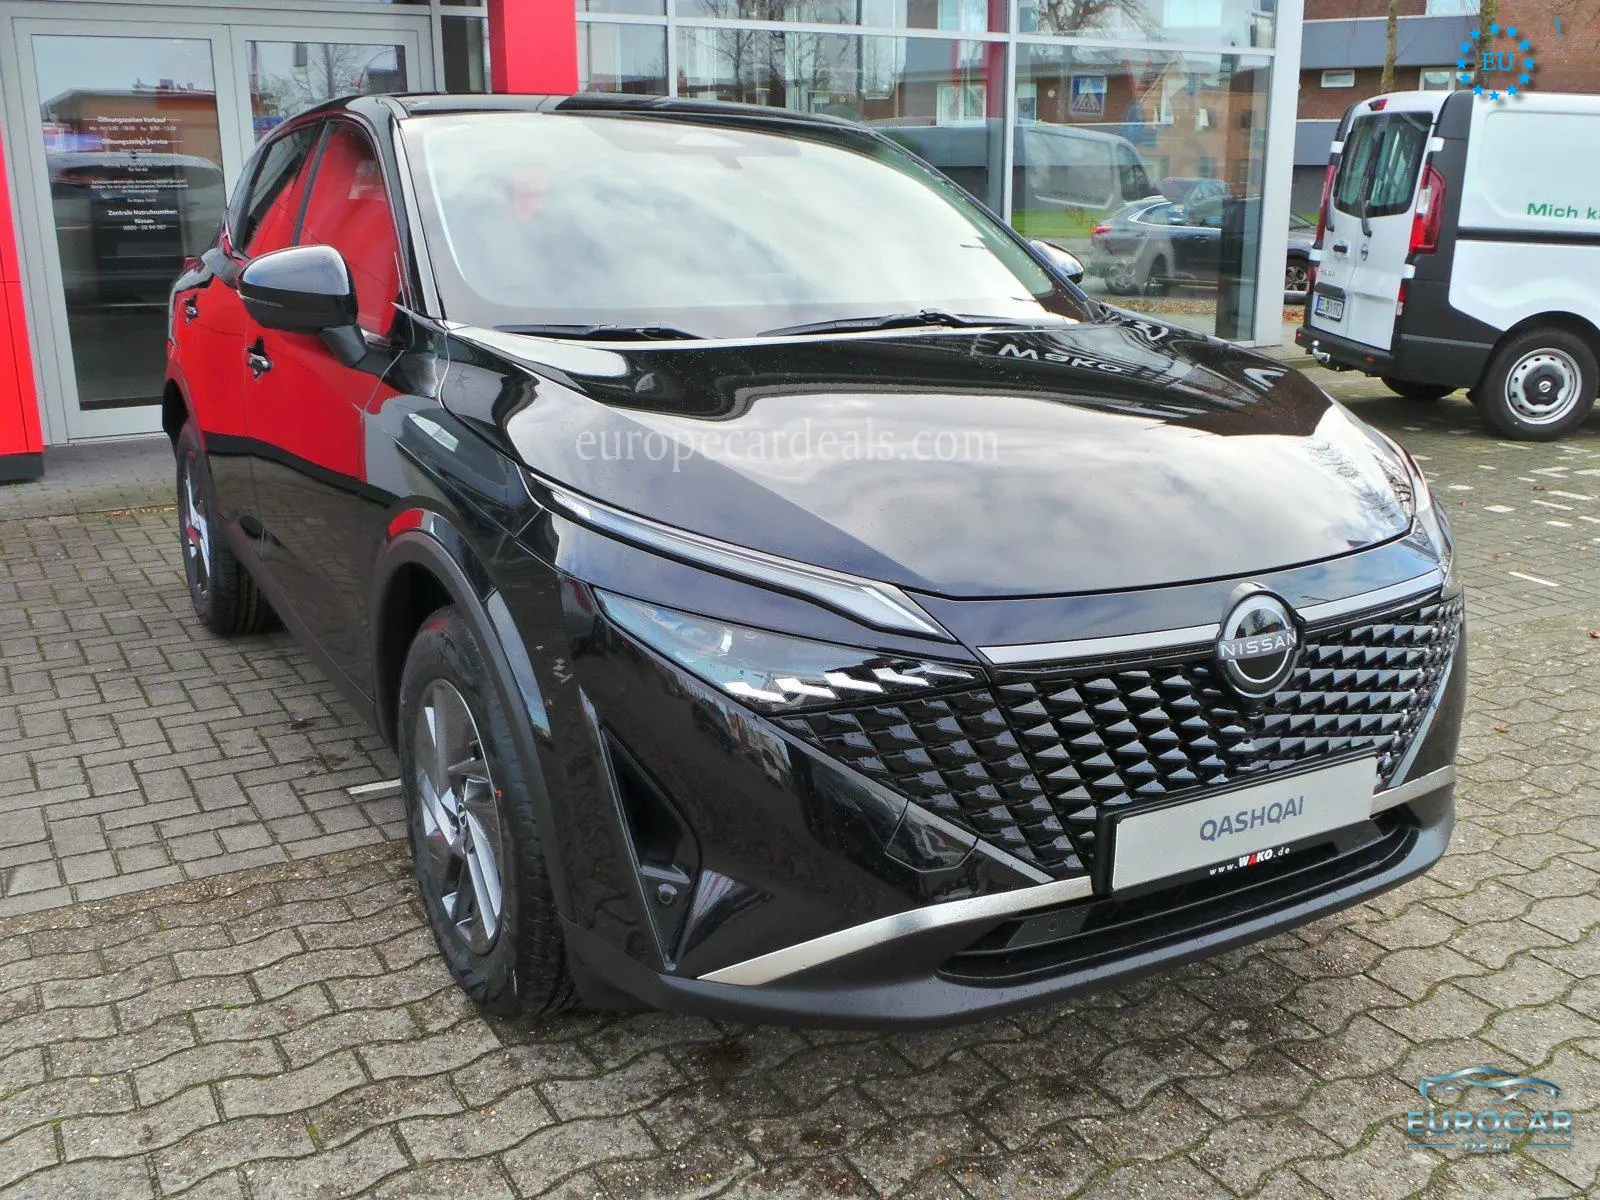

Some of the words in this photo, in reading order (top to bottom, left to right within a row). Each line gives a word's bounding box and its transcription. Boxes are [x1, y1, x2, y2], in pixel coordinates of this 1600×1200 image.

[1527, 202, 1578, 218] Mich
[1586, 206, 1600, 219] k
[1221, 629, 1297, 657] NISSAN
[1199, 795, 1304, 842] QASHQAI
